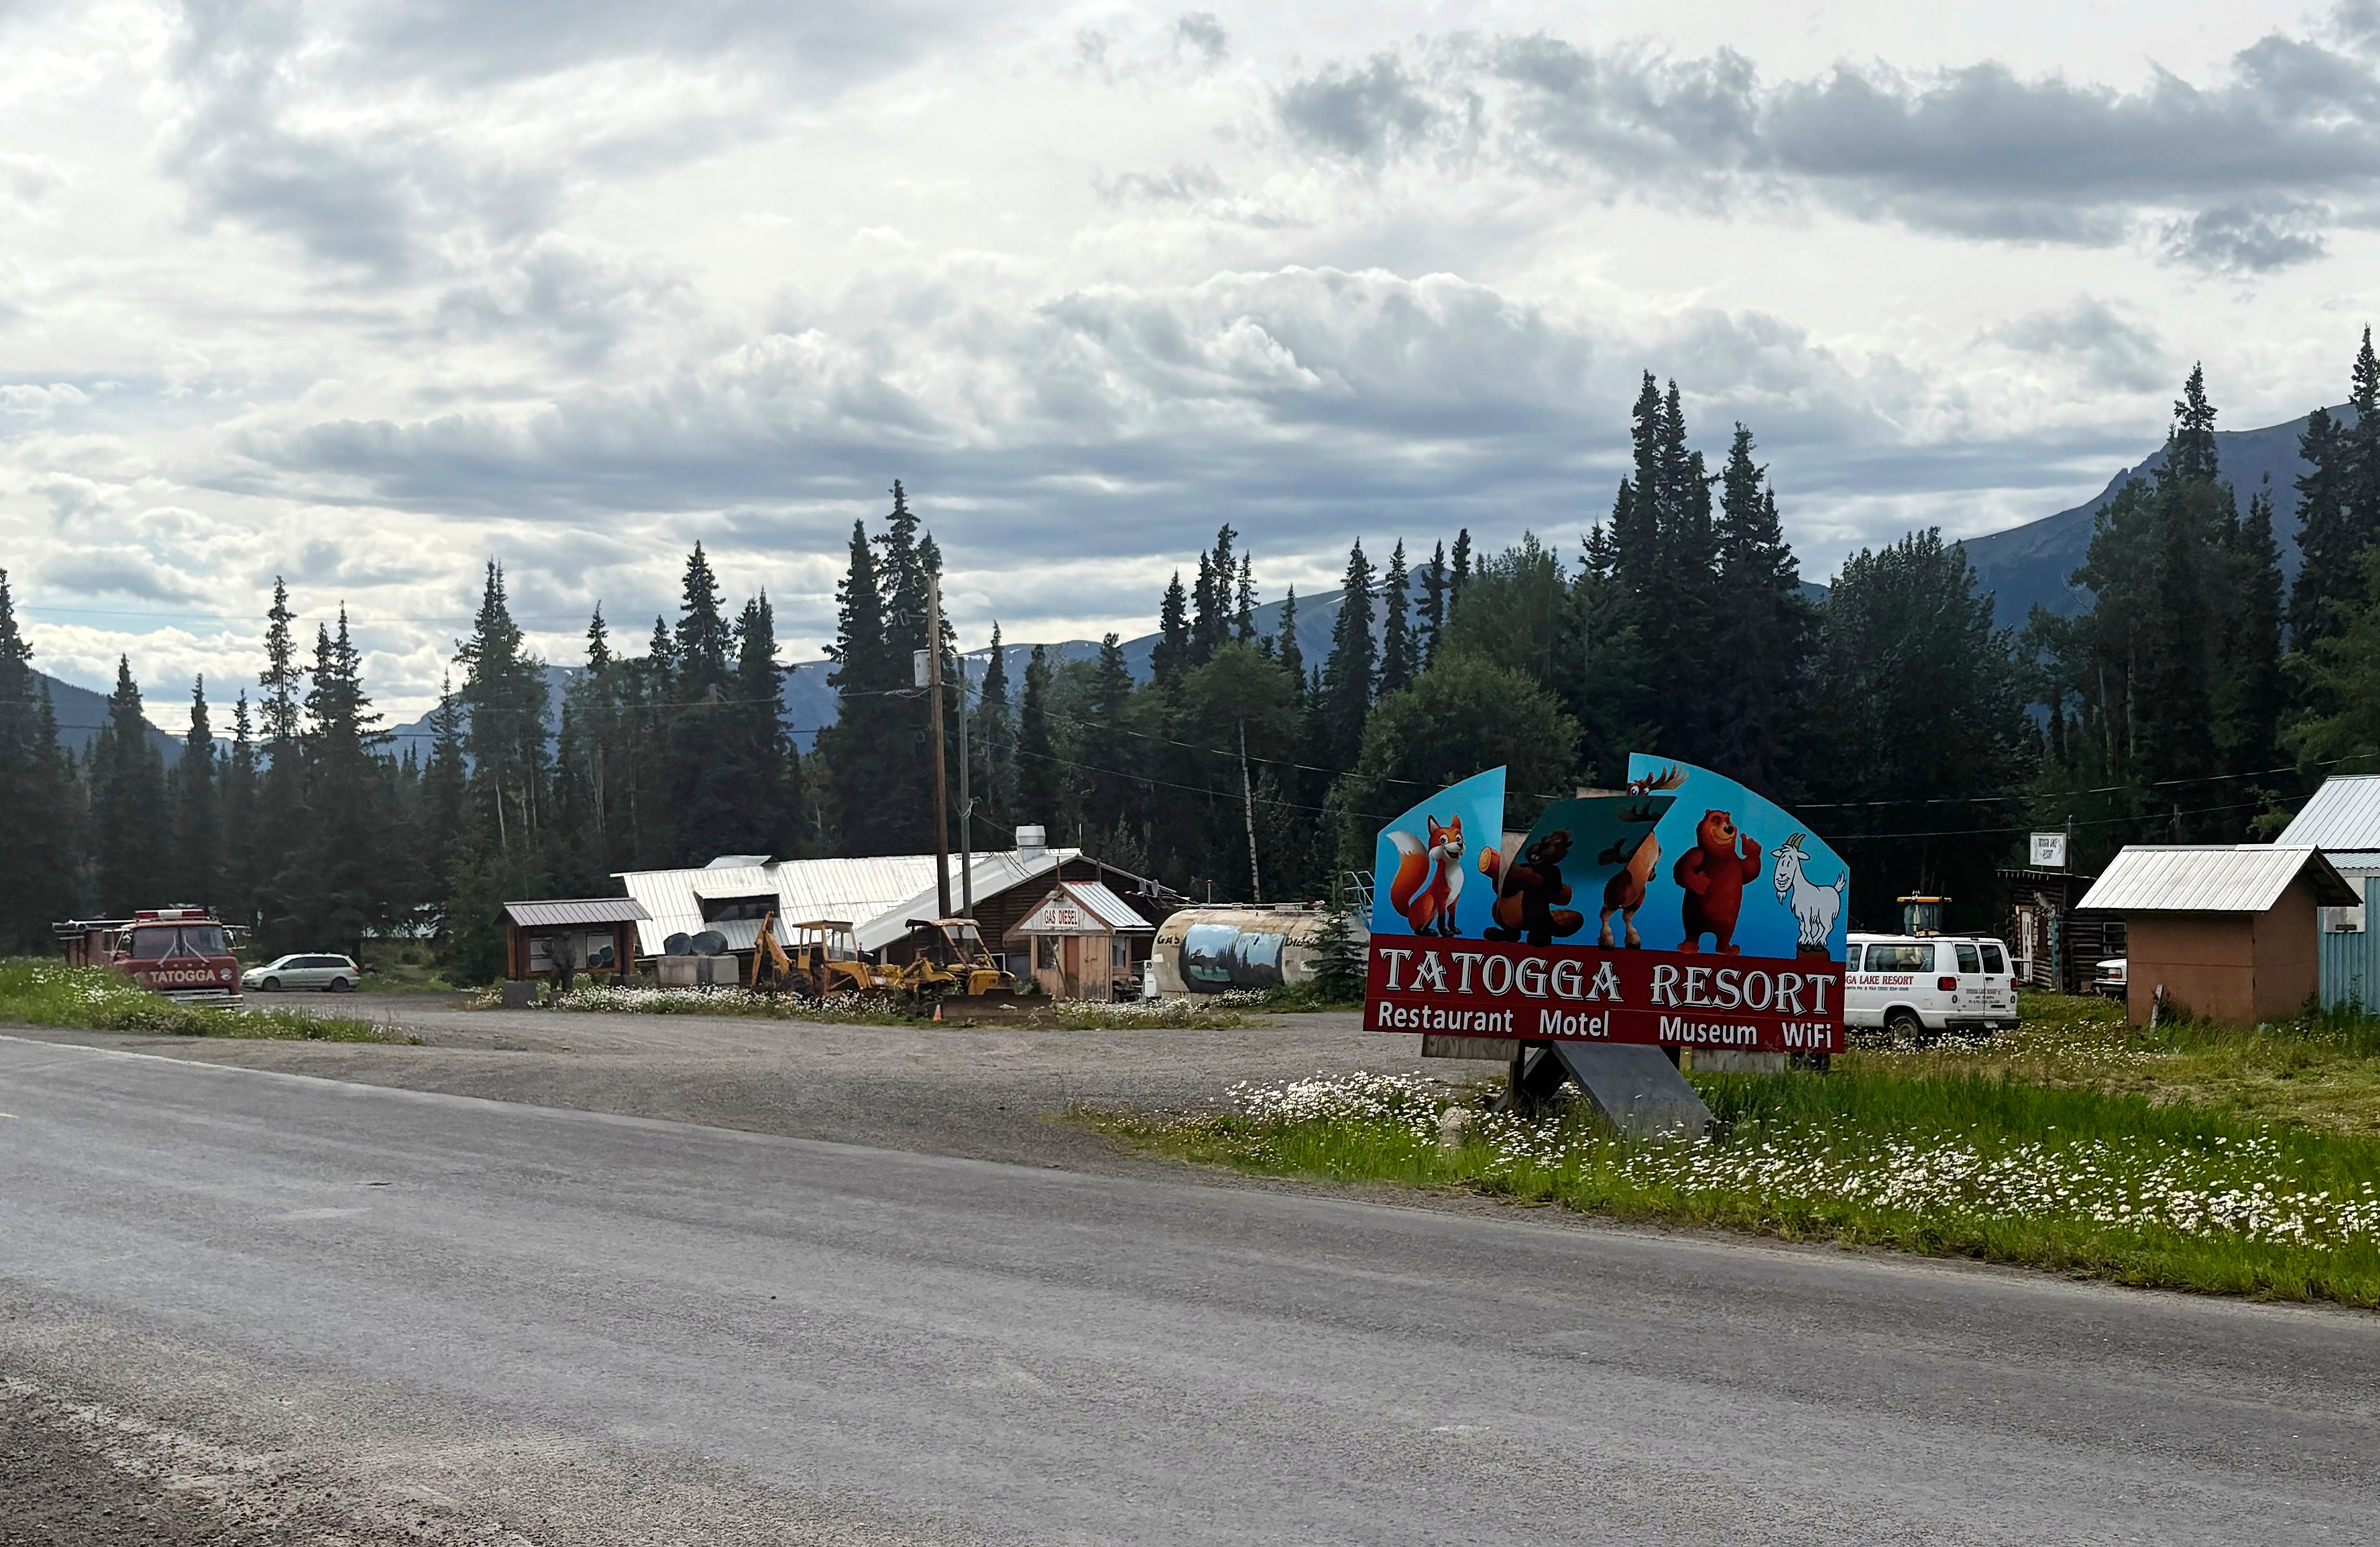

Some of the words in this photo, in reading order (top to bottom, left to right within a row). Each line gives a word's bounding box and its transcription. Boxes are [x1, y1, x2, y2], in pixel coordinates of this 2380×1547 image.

[1044, 910, 1056, 924] GAS
[1059, 910, 1078, 925] DIESEL
[1157, 935, 1180, 944] GAS
[149, 969, 216, 983] TATOGGA
[1379, 948, 1624, 1002] TATOGGA
[1650, 964, 1837, 1016] RESORT
[1859, 975, 1880, 985] LAKE
[1882, 976, 1914, 985] RESORT
[1378, 1001, 1513, 1033] Restaurant
[1539, 1009, 1610, 1037] Motel
[1659, 1016, 1757, 1045] Museum
[1782, 1022, 1831, 1048] WiFi
